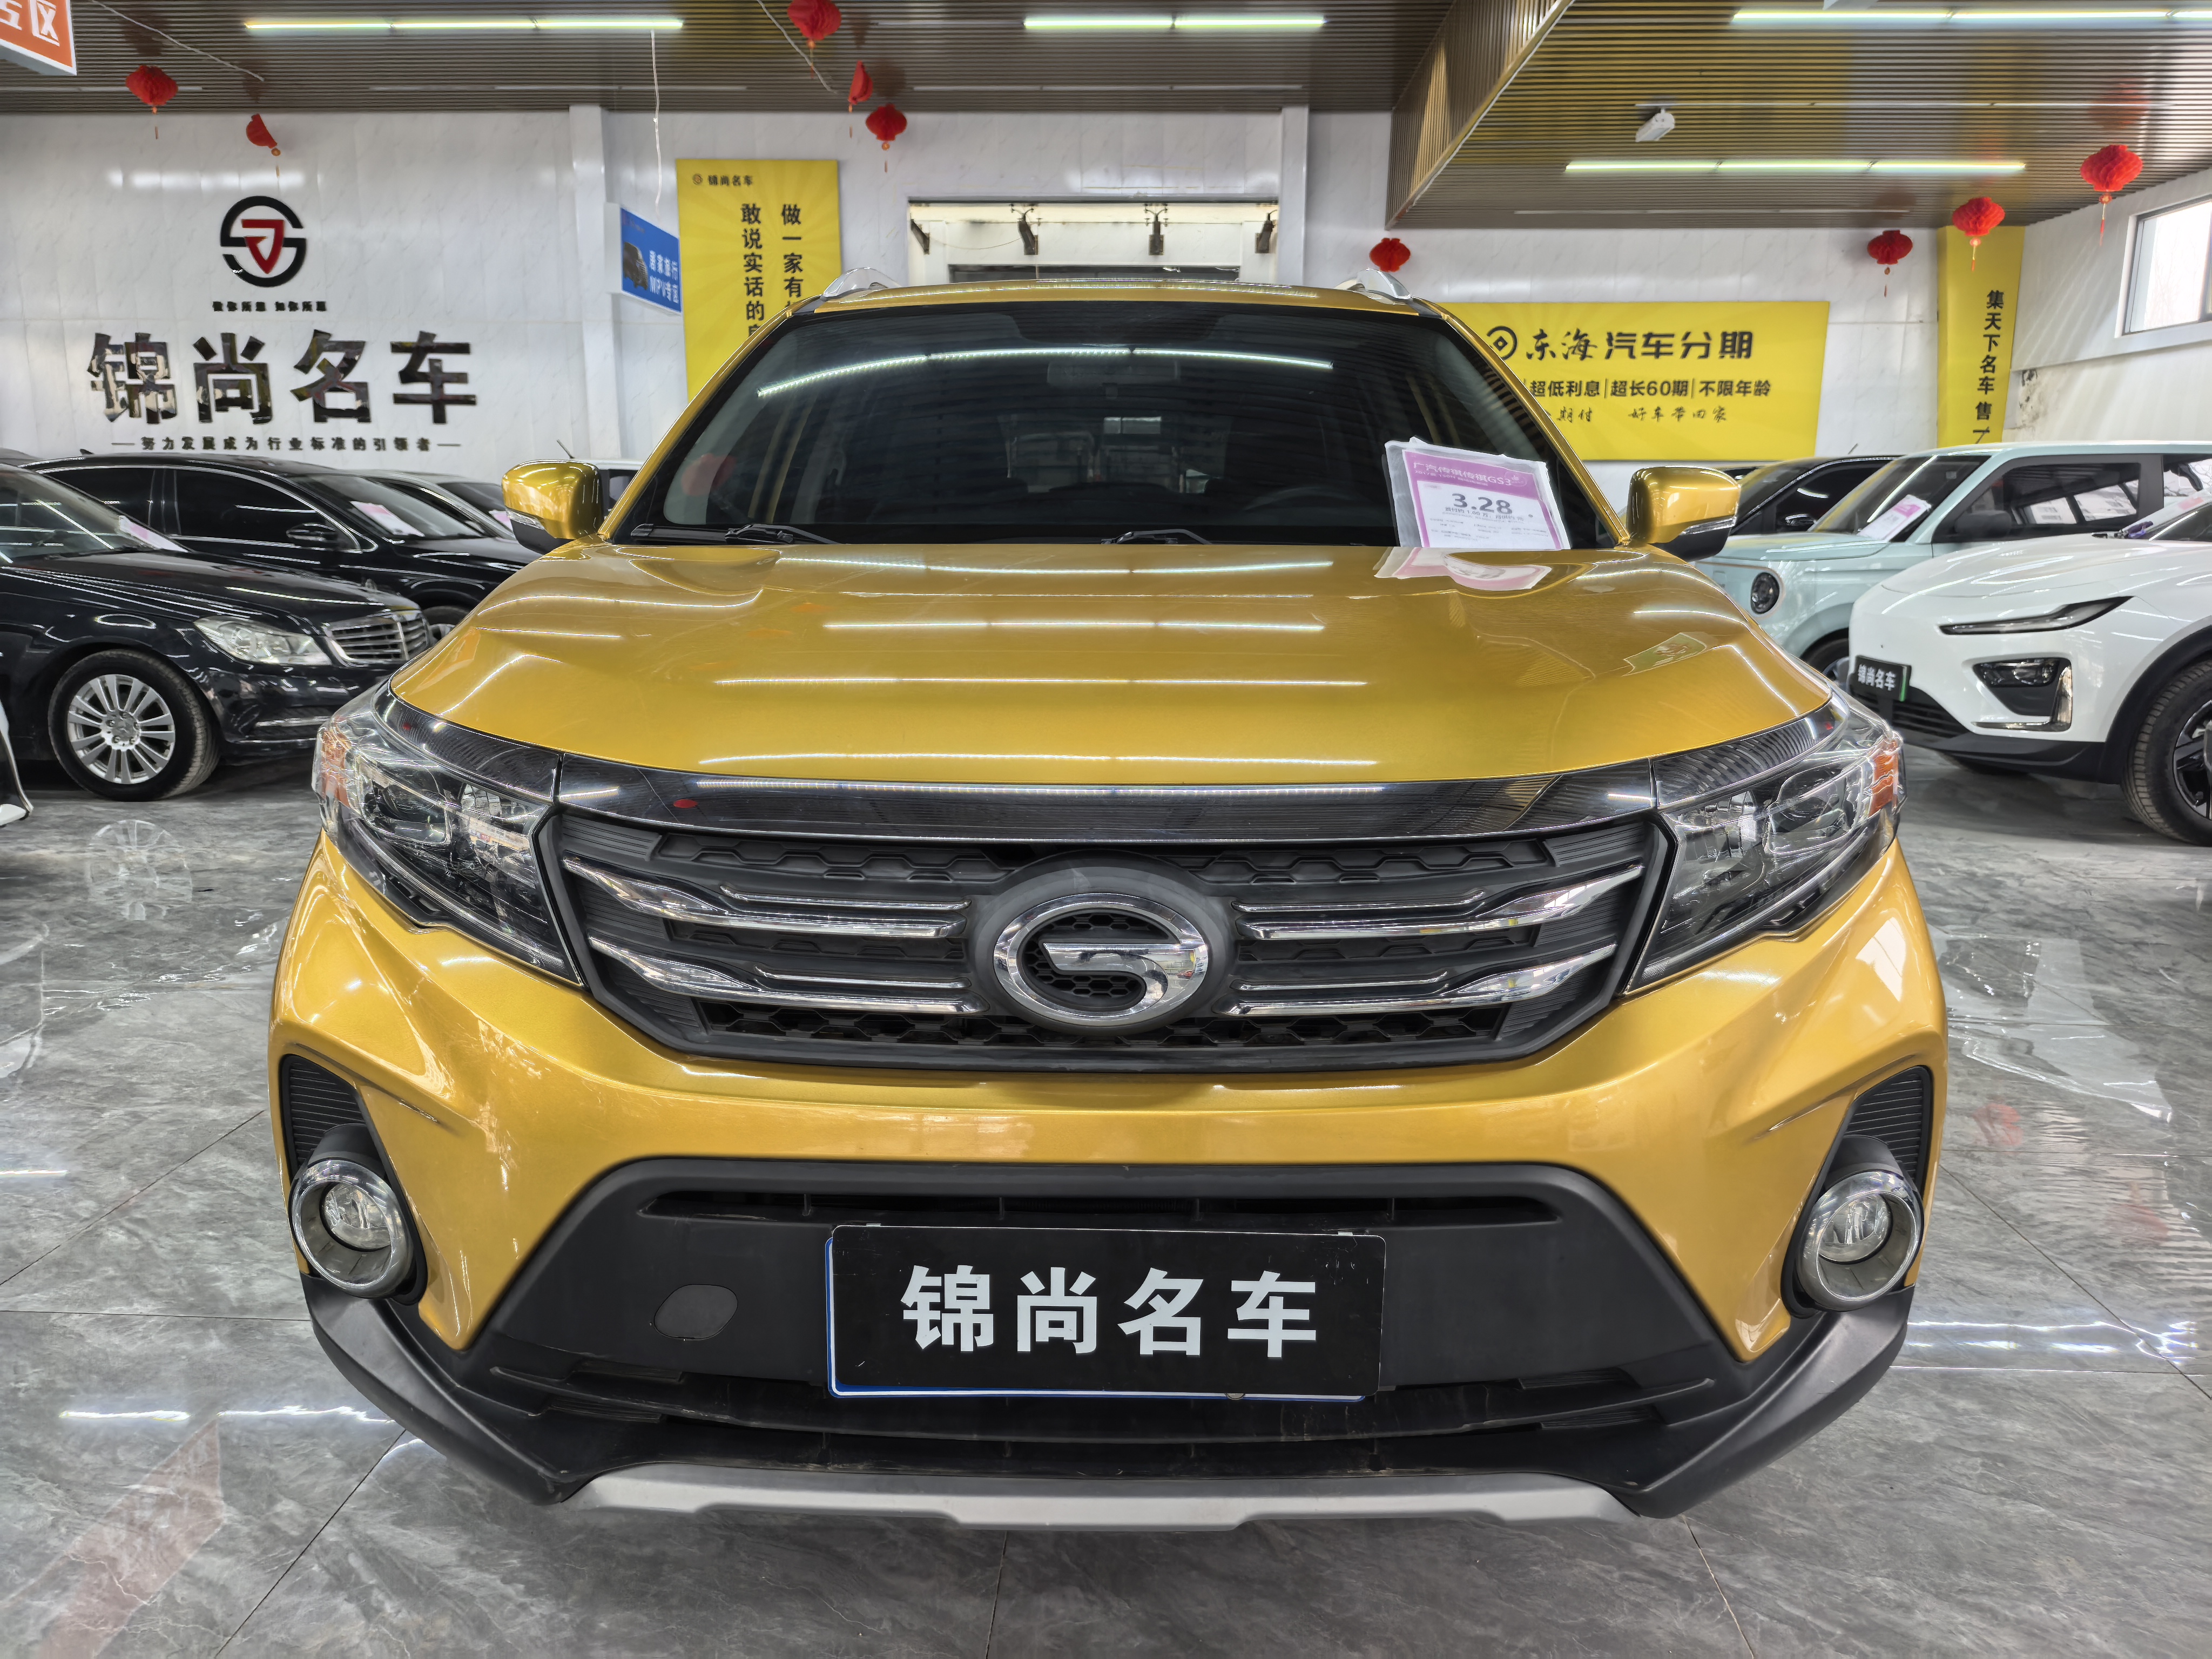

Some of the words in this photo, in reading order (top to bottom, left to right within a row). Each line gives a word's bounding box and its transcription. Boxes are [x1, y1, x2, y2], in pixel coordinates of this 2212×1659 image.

[707, 174, 753, 186] 锦尚名车
[740, 203, 765, 336] 敢说实话的
[781, 203, 804, 308] 做一家有
[87, 329, 477, 424] 锦尚名车
[1452, 493, 1513, 514] 3.28
[1858, 664, 1896, 691] 锦尚名车
[900, 1264, 1317, 1359] 锦尚名车
